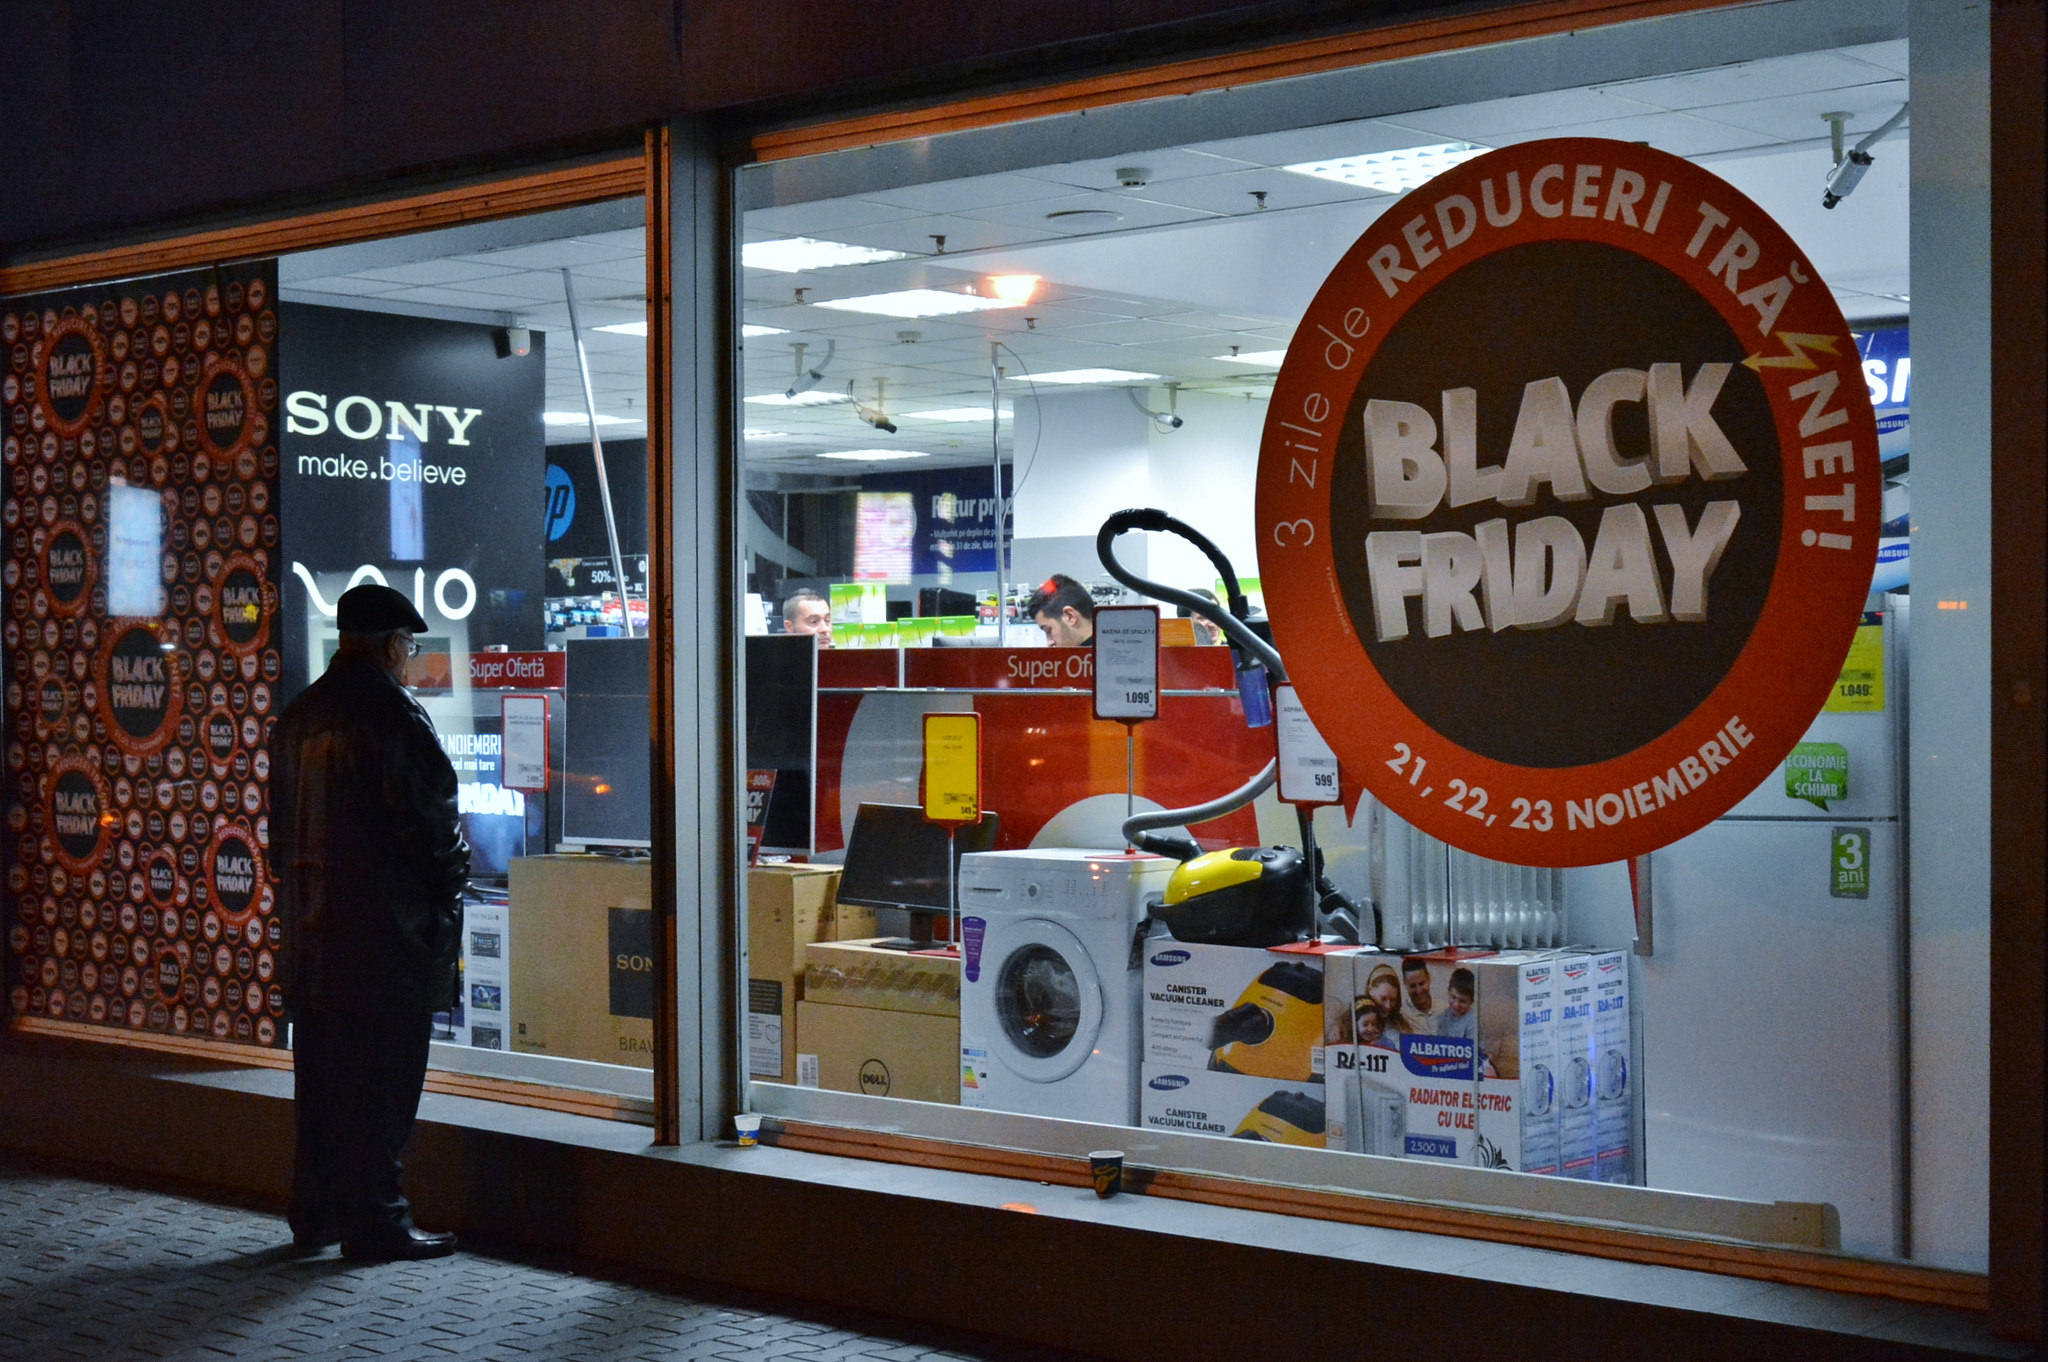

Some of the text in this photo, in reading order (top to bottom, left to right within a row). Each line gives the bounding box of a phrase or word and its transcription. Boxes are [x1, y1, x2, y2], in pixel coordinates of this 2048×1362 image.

[1366, 162, 1673, 299] REDUCERI
[1317, 305, 1371, 371] de
[50, 352, 93, 376] BLACK
[207, 390, 244, 410] BLACK
[286, 390, 483, 447] SONY
[1287, 391, 1330, 489] zile
[1363, 361, 1749, 520] BLACK
[298, 453, 467, 487] make.believe
[1275, 517, 1315, 548] 3
[1366, 500, 1742, 643] FRIDAY
[112, 656, 166, 682] BLACK
[469, 657, 546, 684] Super Ofertă
[1007, 655, 1062, 683] Super
[112, 684, 165, 709] FRIDAY
[464, 758, 478, 771] mai
[479, 759, 495, 771] tare
[1384, 714, 1756, 832] 21, 22, 23 NOIEMBRIE
[1314, 774, 1332, 787] 599
[1809, 769, 1823, 783] LA
[1794, 782, 1838, 798] SCHIMB
[55, 791, 98, 814] BLACK
[1838, 833, 1863, 870] 3
[216, 855, 254, 875] BLACK
[1838, 867, 1865, 883] ani
[216, 874, 253, 894] FRIDAY
[1150, 992, 1225, 1008] VACUUM CLEANER
[1166, 984, 1207, 996] CANISTER
[1410, 1042, 1472, 1059] ALBATROS
[862, 1074, 887, 1086] DELL
[1409, 1087, 1460, 1108] RADIATOR
[1148, 1115, 1226, 1133] VACUUM CLEANER
[1166, 1107, 1208, 1121] CANISTER
[1438, 1110, 1452, 1128] CU
[1410, 1140, 1450, 1154] 2500 W
